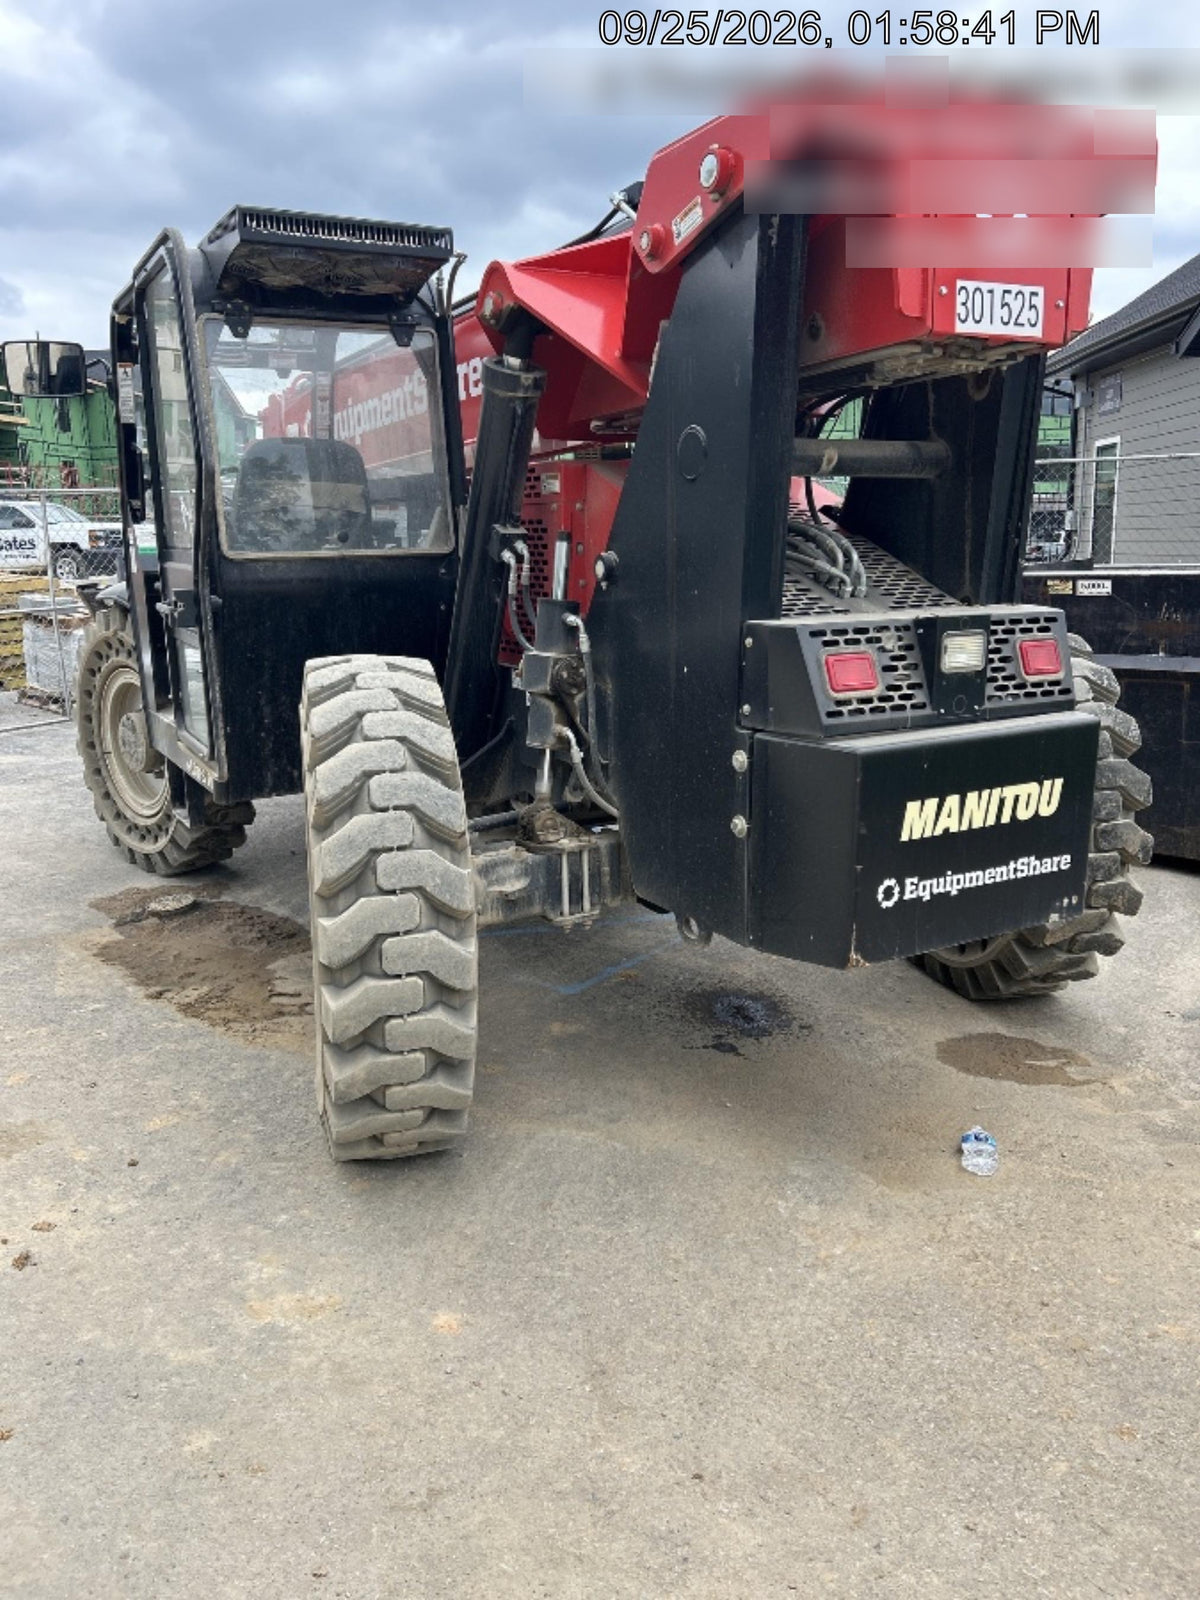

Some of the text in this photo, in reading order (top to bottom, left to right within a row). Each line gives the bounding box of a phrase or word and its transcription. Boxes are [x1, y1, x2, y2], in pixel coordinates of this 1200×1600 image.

[957, 285, 1040, 328] 301525
[900, 777, 1064, 842] MANITOU
[903, 854, 1071, 901] EquipmentShare
